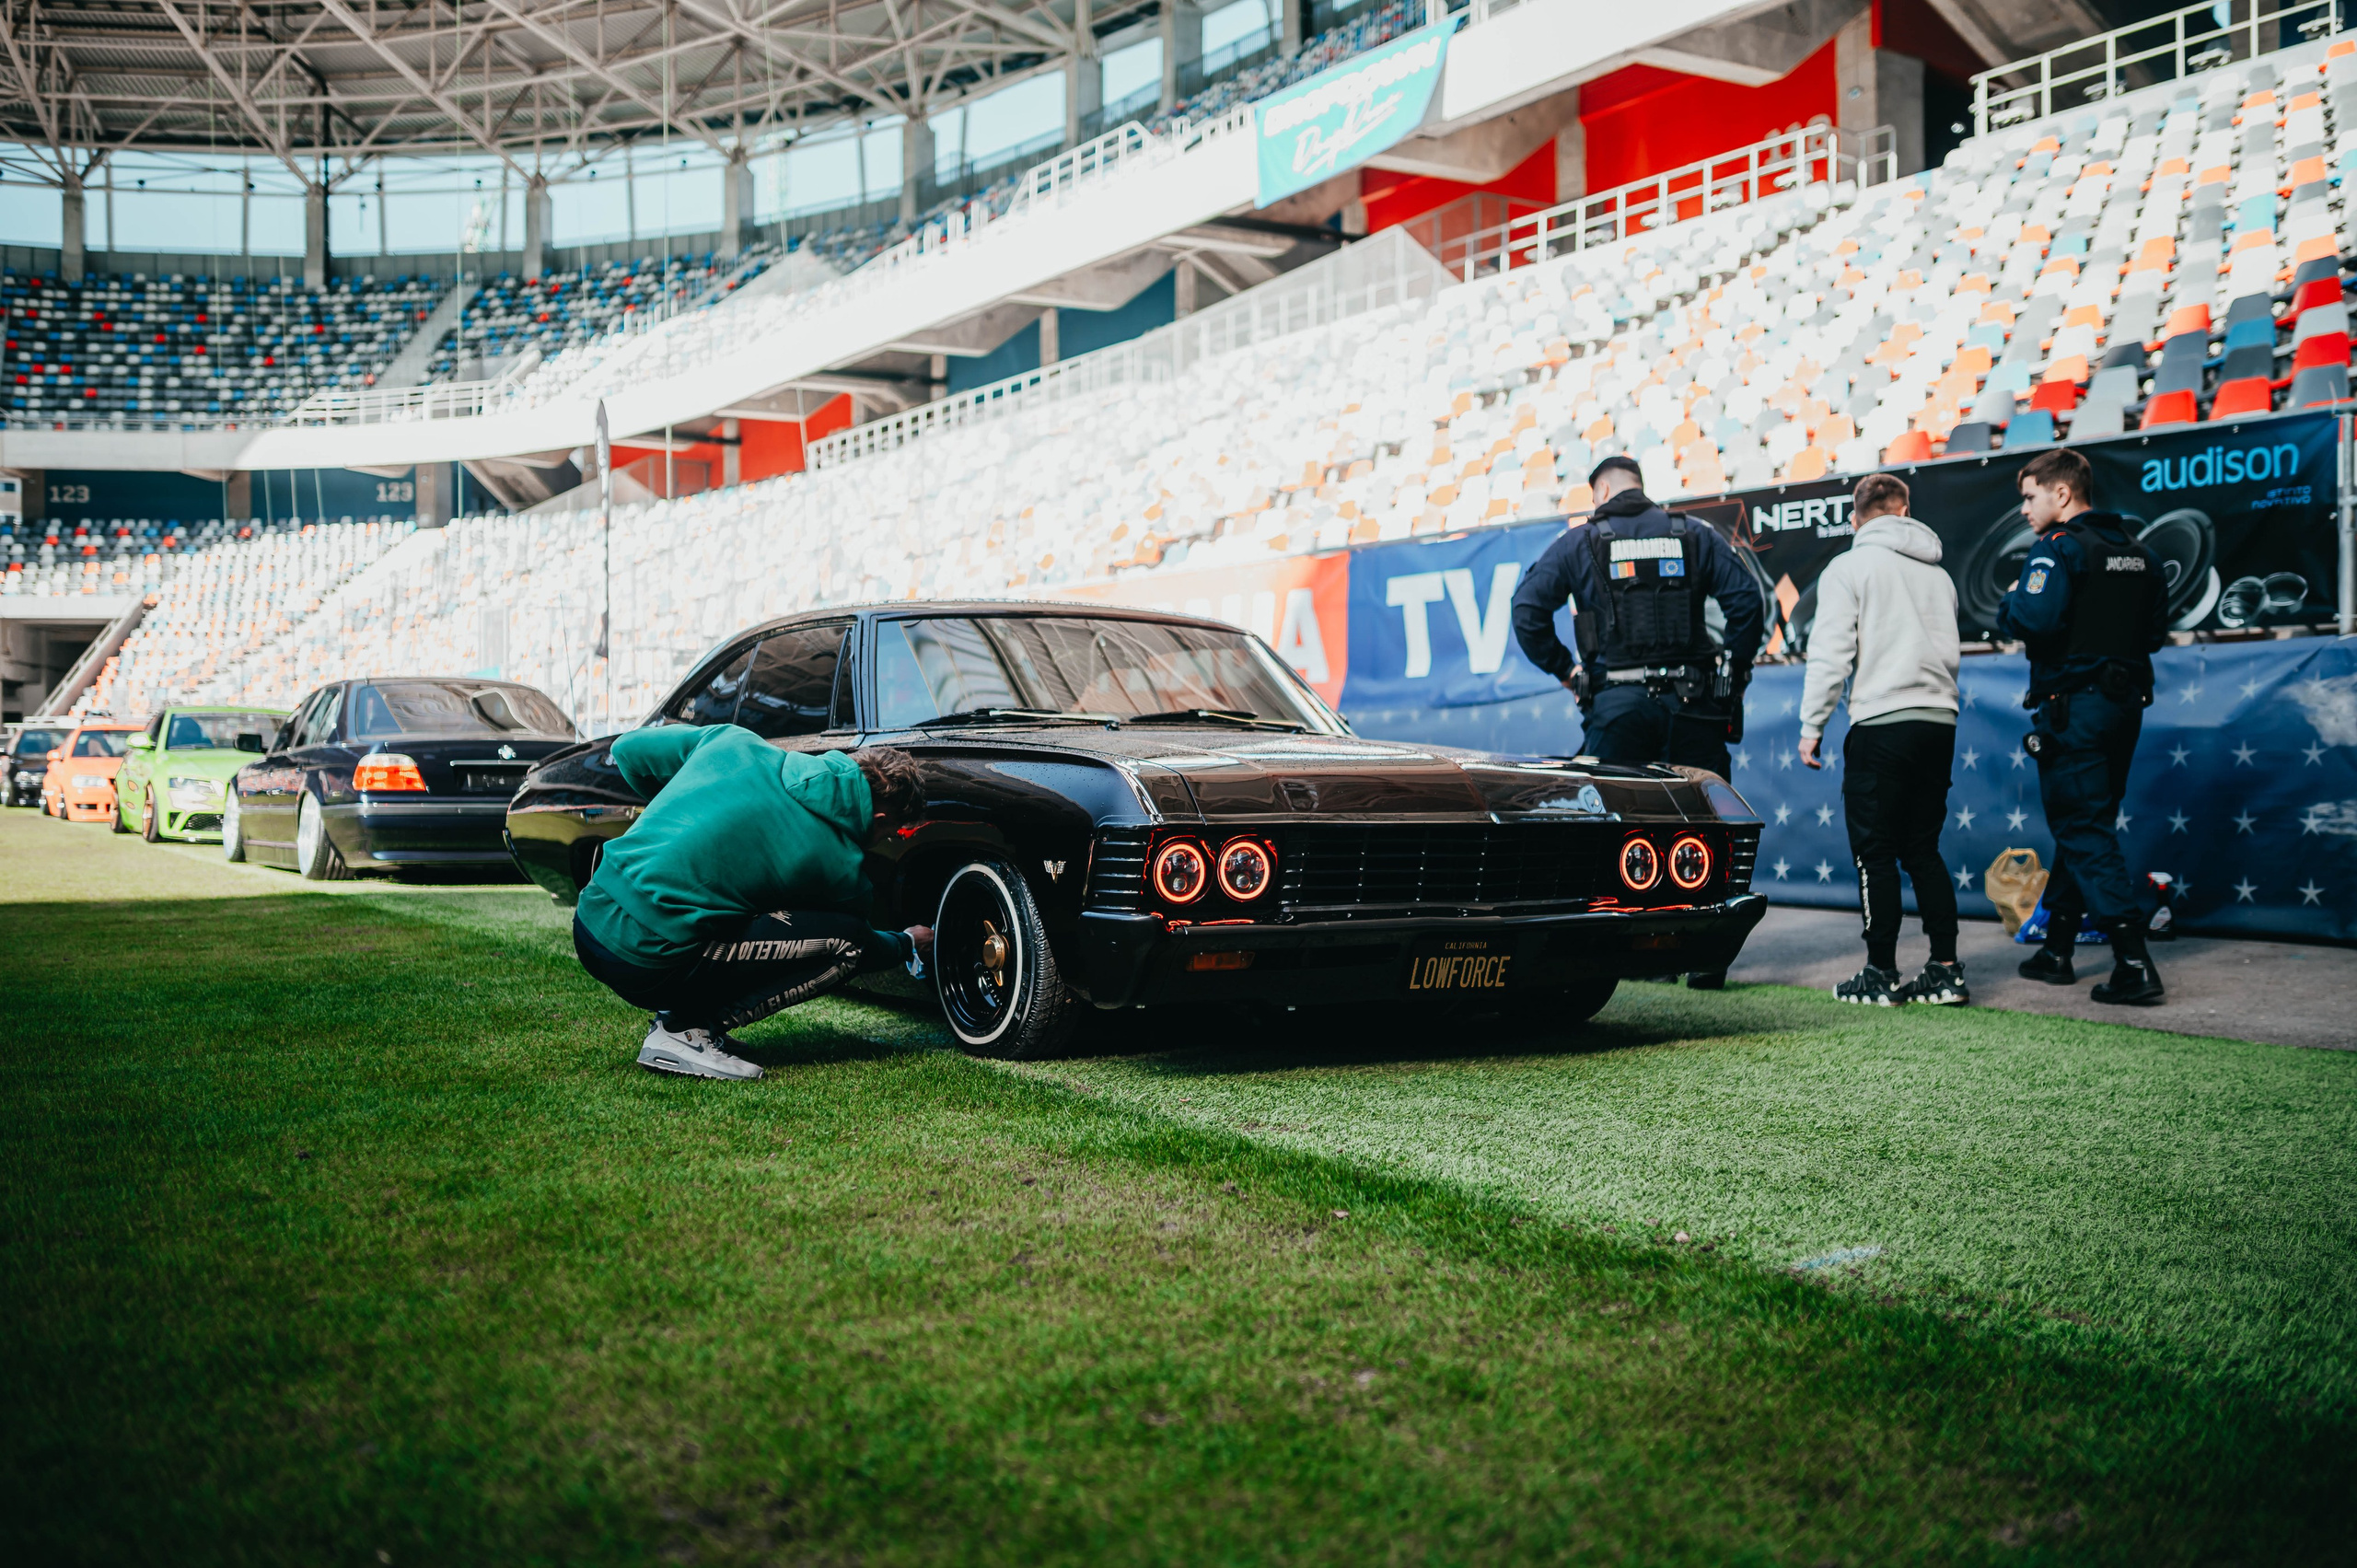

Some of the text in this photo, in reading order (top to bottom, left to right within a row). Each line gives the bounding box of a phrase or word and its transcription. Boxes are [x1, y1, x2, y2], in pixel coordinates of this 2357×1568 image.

[2141, 443, 2300, 493] audison
[50, 484, 90, 504] 123
[376, 481, 414, 503] 123
[1752, 494, 1857, 534] HERT
[1386, 562, 1522, 679] TV
[1445, 942, 1488, 950] CALIFORNIA
[1410, 956, 1511, 990] LOWFORCE
